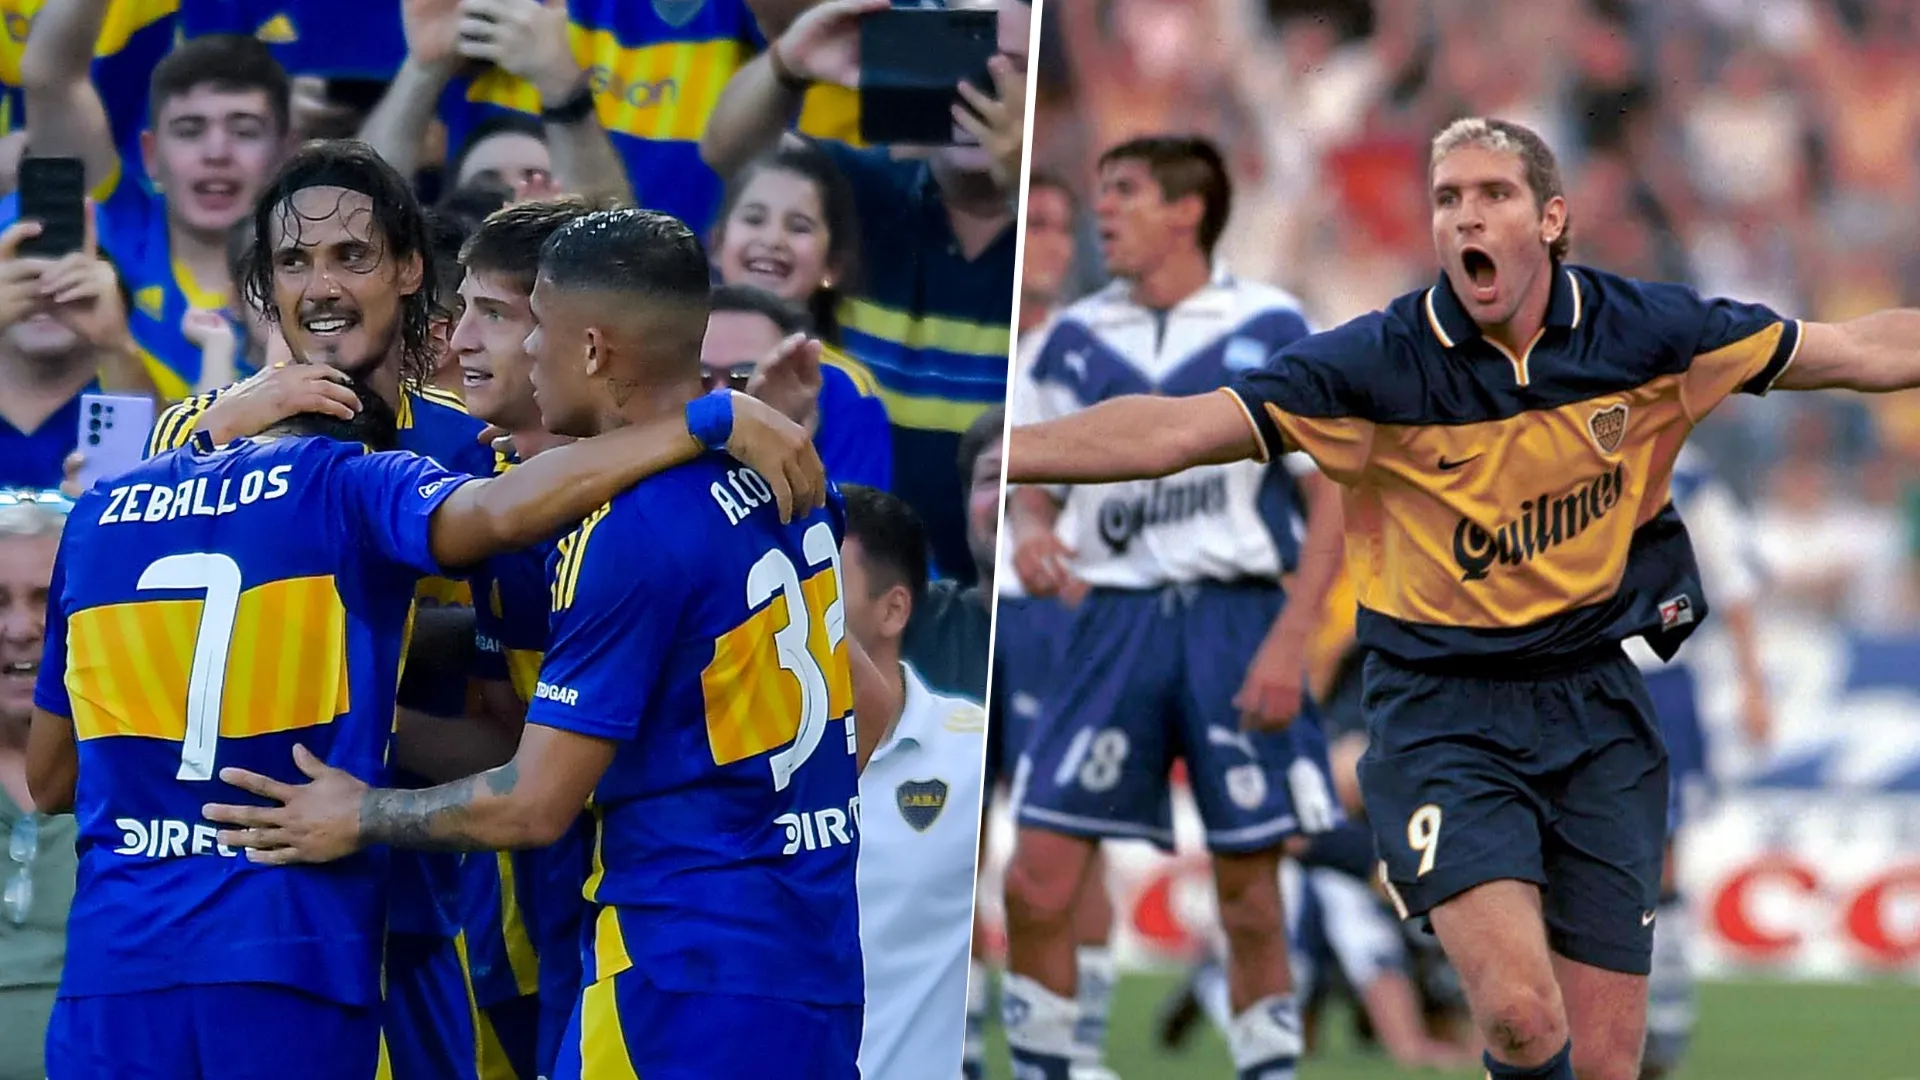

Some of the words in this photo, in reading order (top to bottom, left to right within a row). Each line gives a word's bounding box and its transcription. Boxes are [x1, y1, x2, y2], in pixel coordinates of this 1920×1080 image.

[98, 464, 292, 526] ZEBALLOS
[1452, 460, 1623, 582] Quilmes
[136, 552, 242, 781] 7
[1055, 726, 1131, 793] 18
[1407, 803, 1442, 877] 9
